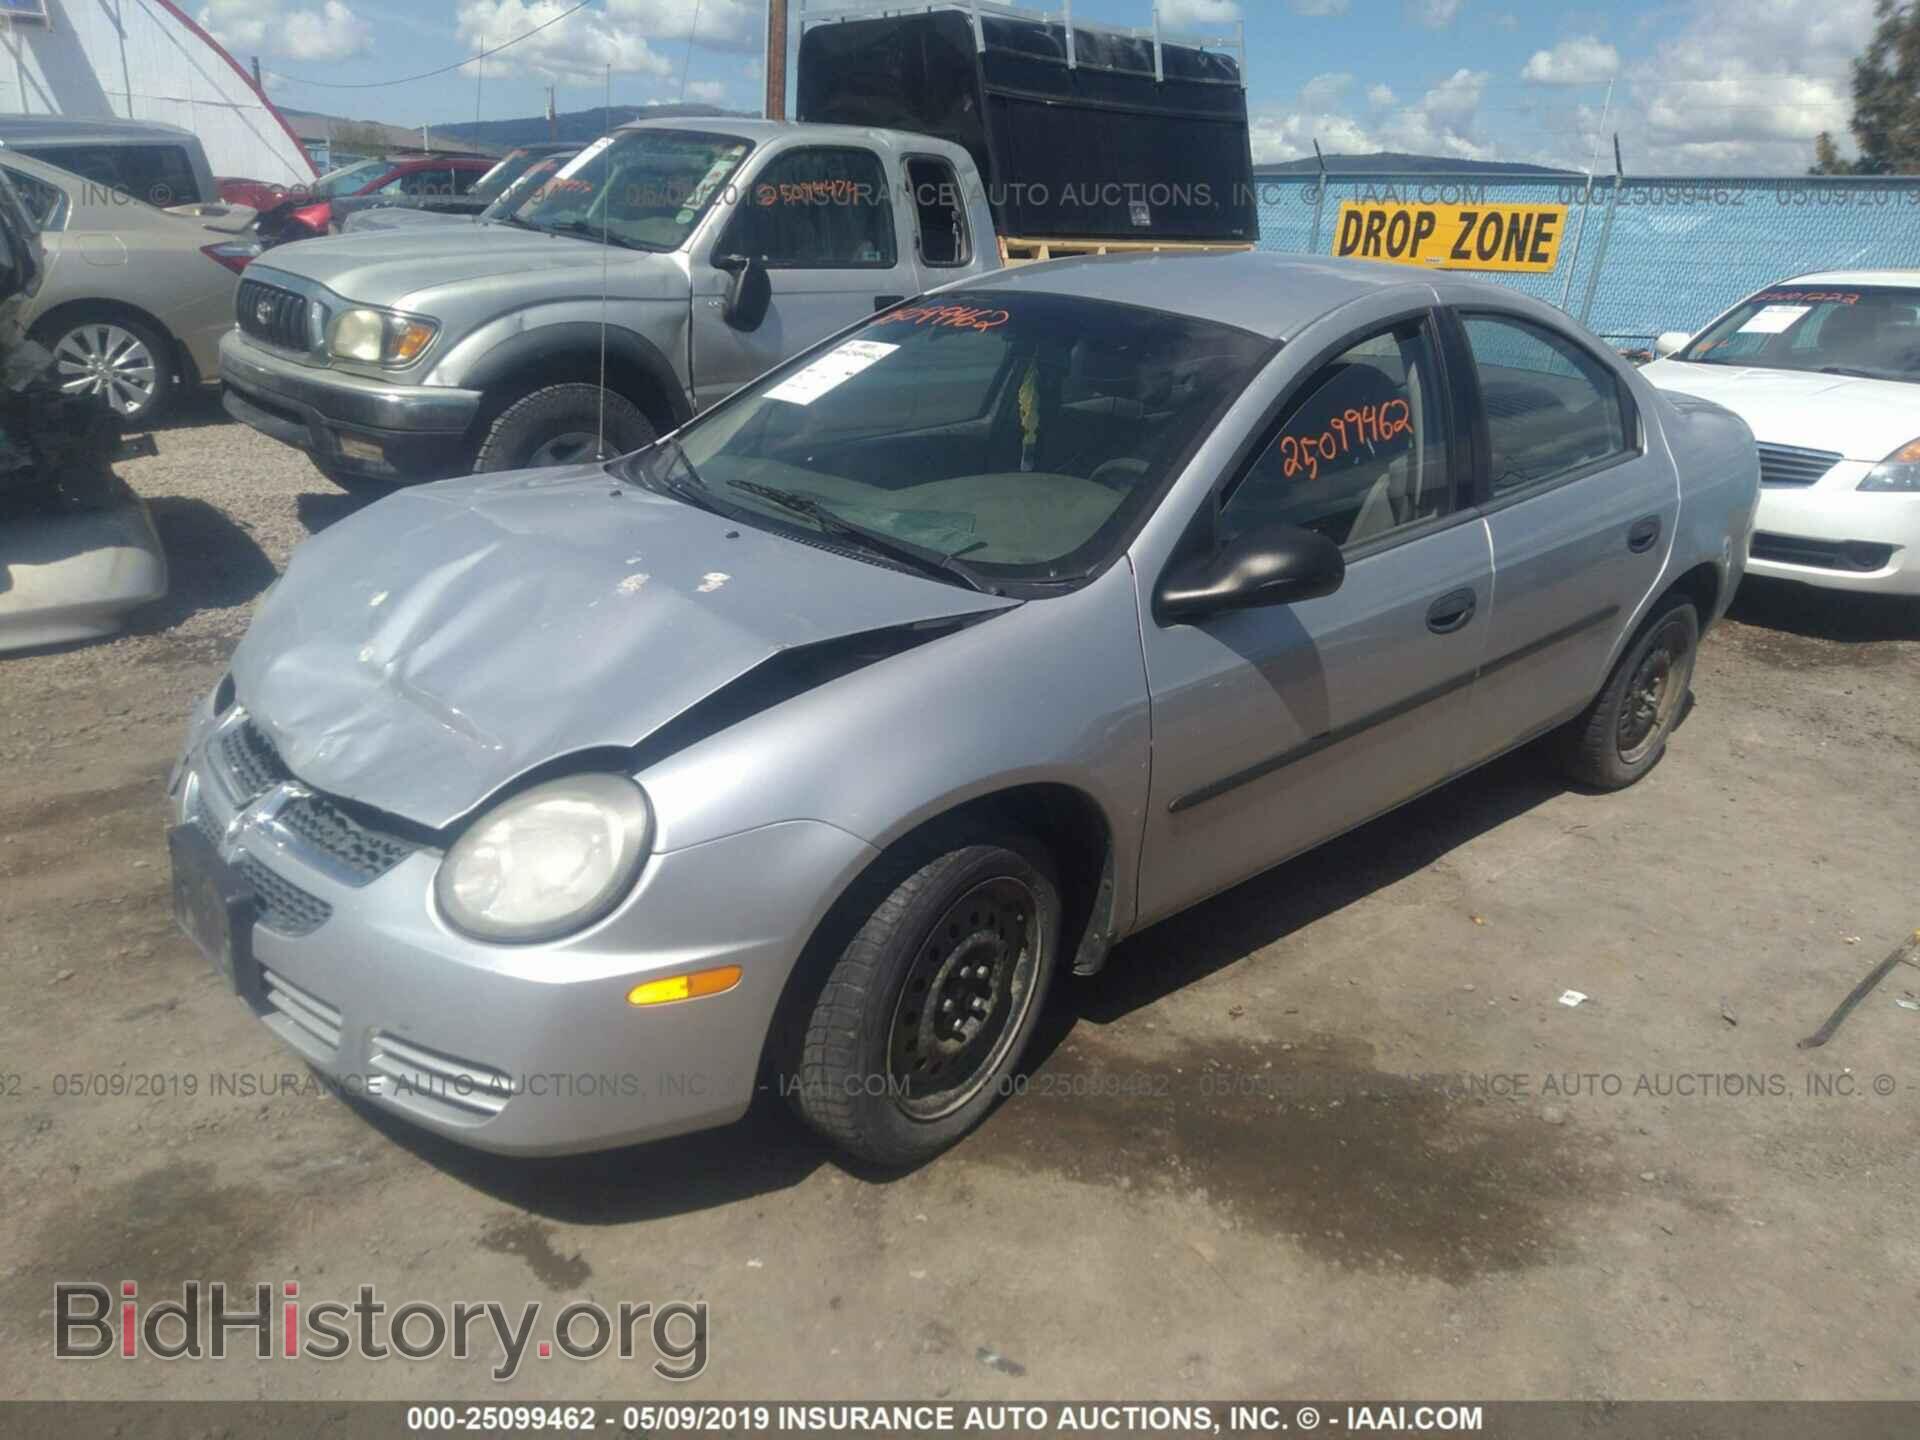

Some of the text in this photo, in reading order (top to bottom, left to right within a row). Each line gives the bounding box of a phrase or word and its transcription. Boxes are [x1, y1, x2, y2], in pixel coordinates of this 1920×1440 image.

[1338, 209, 1559, 263] DROP ZONE
[1280, 399, 1414, 480] 25099462
